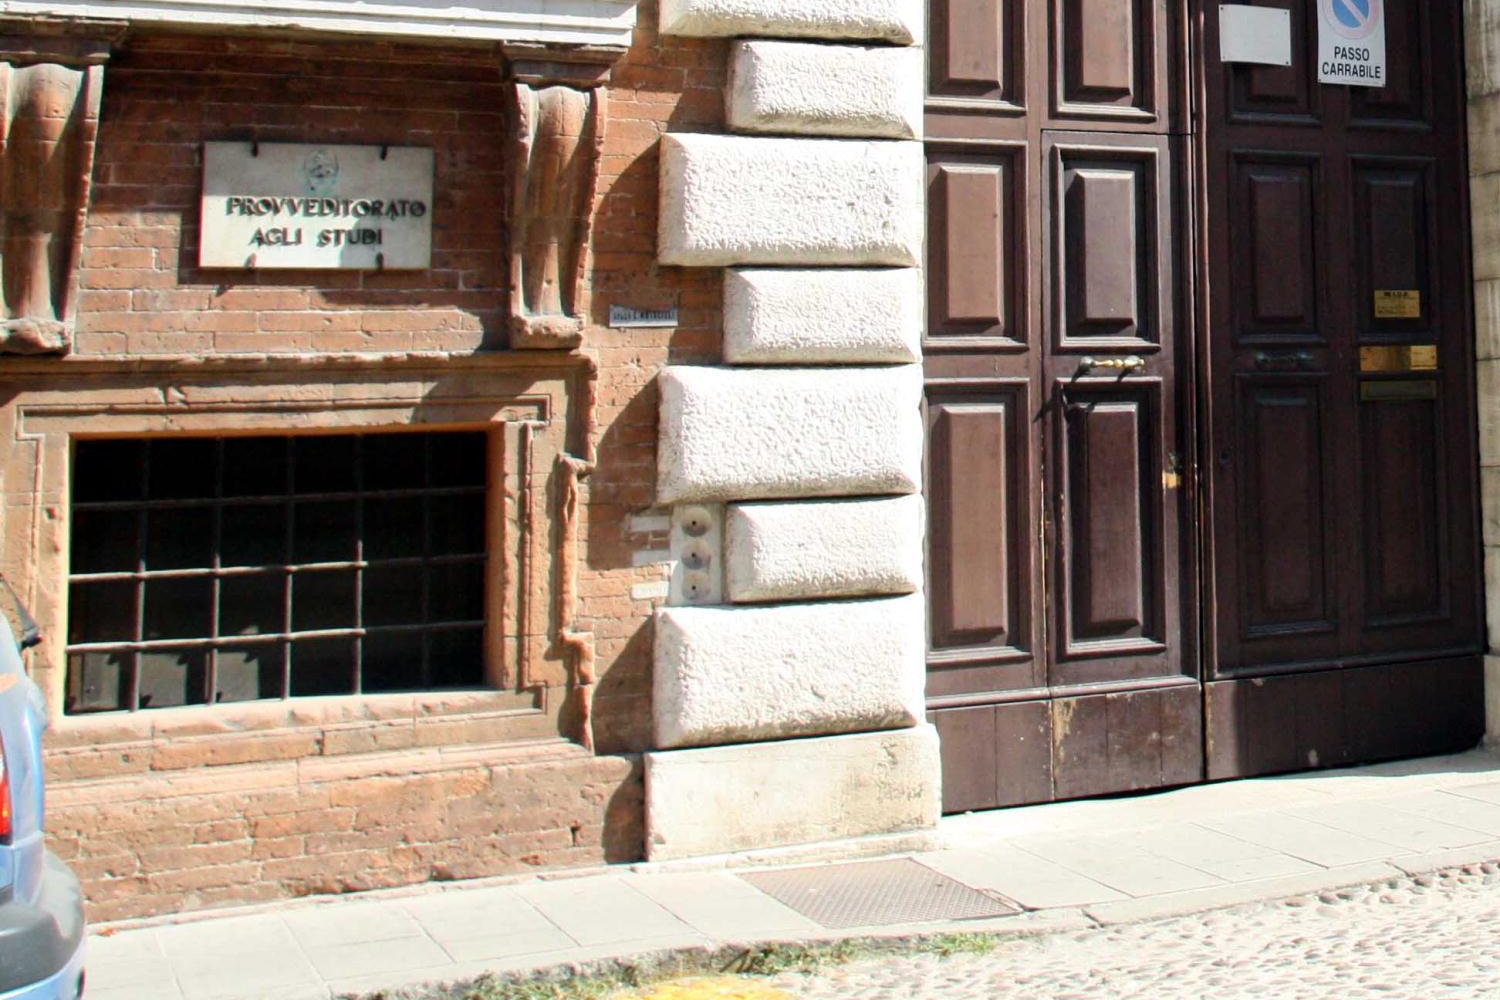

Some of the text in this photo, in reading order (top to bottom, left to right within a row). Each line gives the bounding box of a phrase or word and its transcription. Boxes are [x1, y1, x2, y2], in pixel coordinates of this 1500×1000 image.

[1334, 45, 1370, 61] PASSO
[1322, 61, 1381, 79] CARRABILE
[225, 197, 426, 219] PROVVEDITORATO
[250, 227, 382, 247] AGLI STUDI
